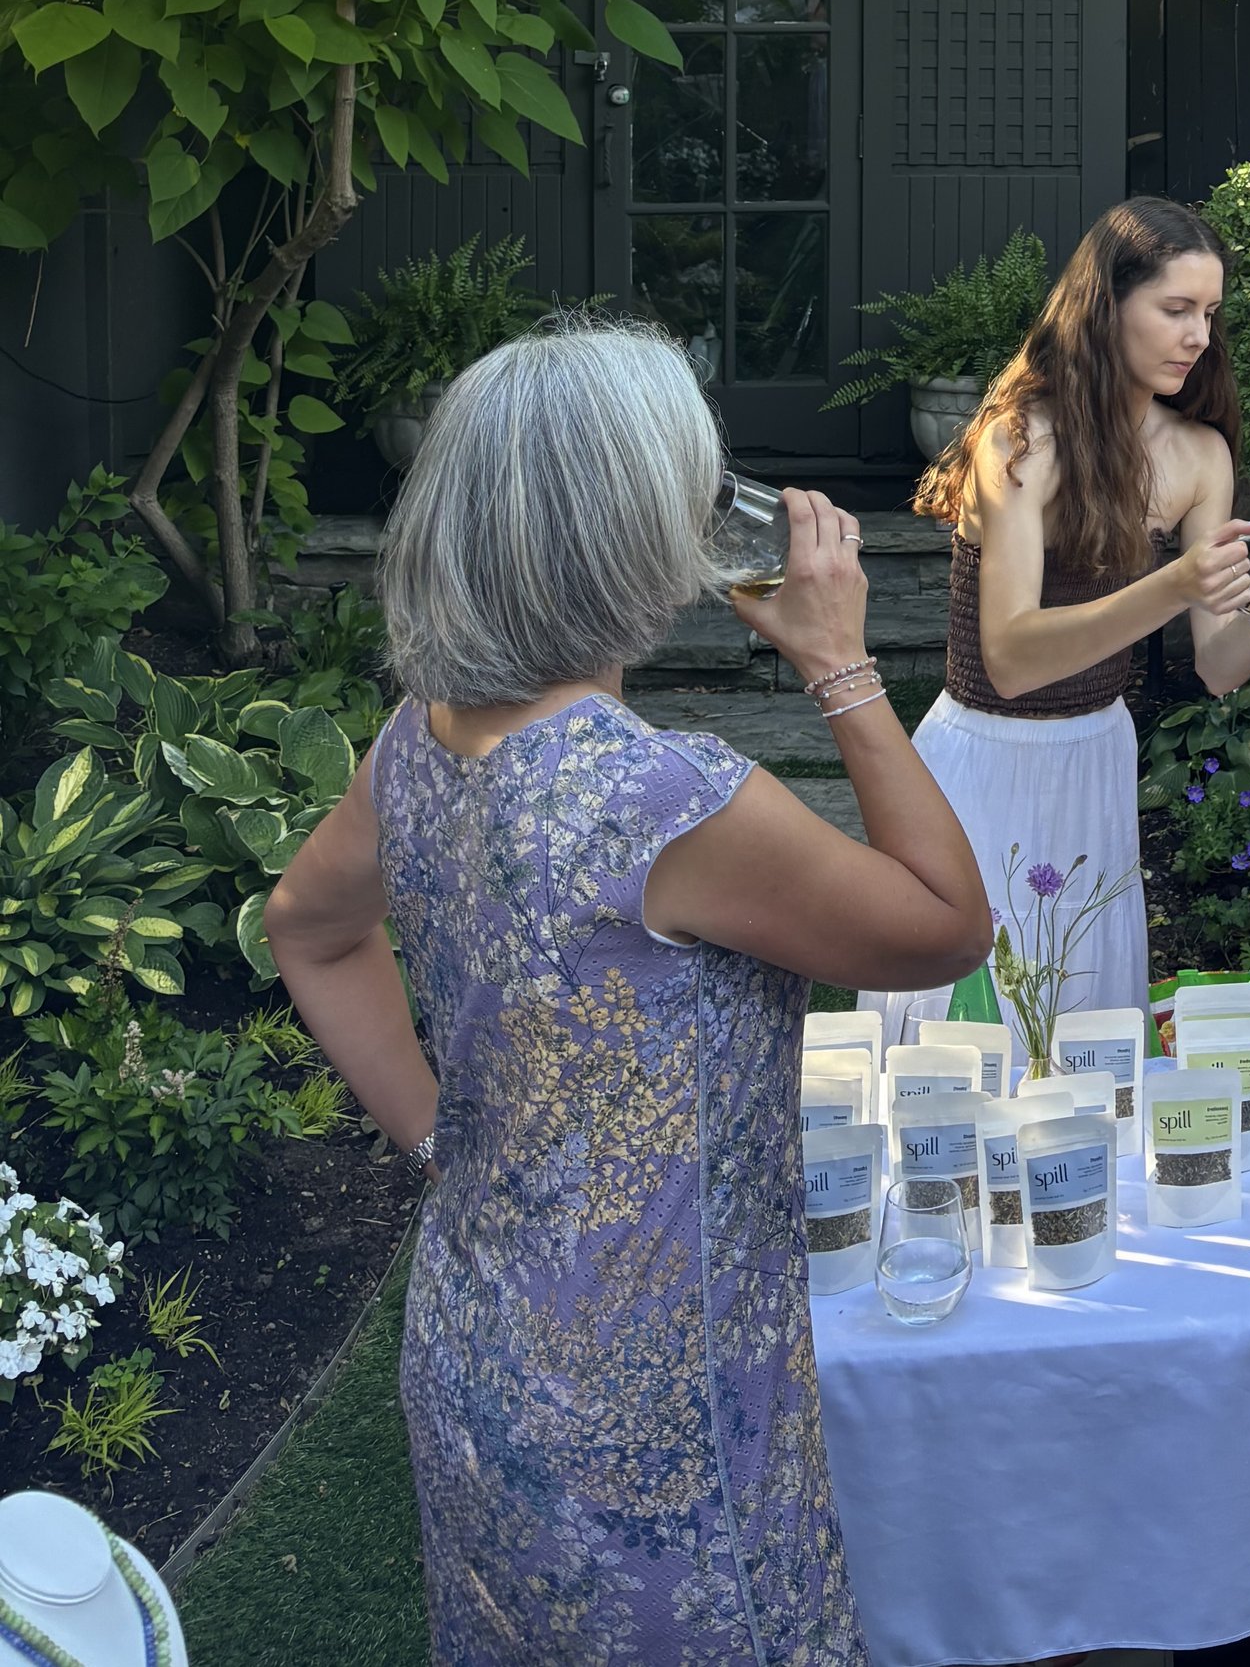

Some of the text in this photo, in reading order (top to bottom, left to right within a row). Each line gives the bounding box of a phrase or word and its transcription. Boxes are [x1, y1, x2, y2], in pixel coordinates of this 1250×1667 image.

[1065, 1050, 1095, 1072] spill
[1159, 1110, 1192, 1134] spill
[906, 1136, 939, 1161] spill
[804, 1171, 829, 1194] pill
[1034, 1163, 1069, 1191] spill
